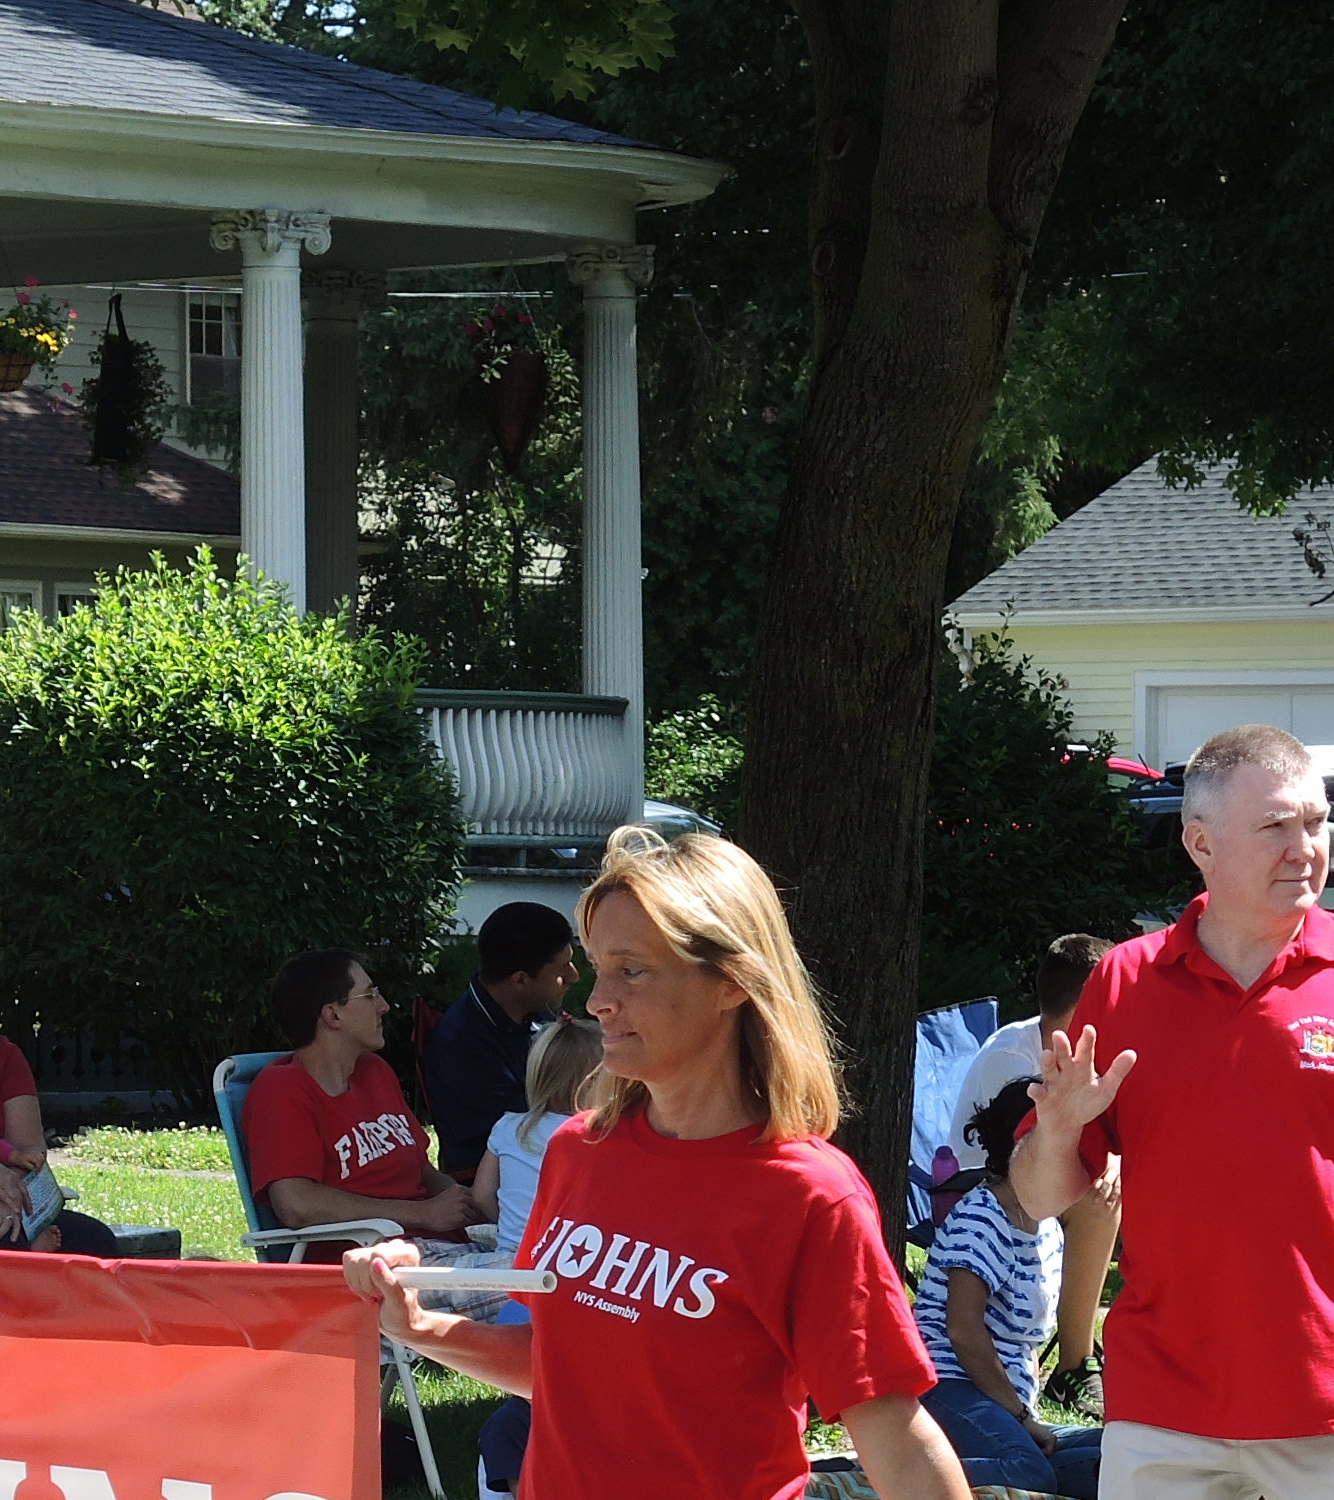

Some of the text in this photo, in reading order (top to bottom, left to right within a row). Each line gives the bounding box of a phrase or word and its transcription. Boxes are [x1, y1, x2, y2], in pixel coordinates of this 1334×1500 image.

[535, 1219, 730, 1319] JOHNS
[573, 1290, 641, 1324] NYS Assembly
